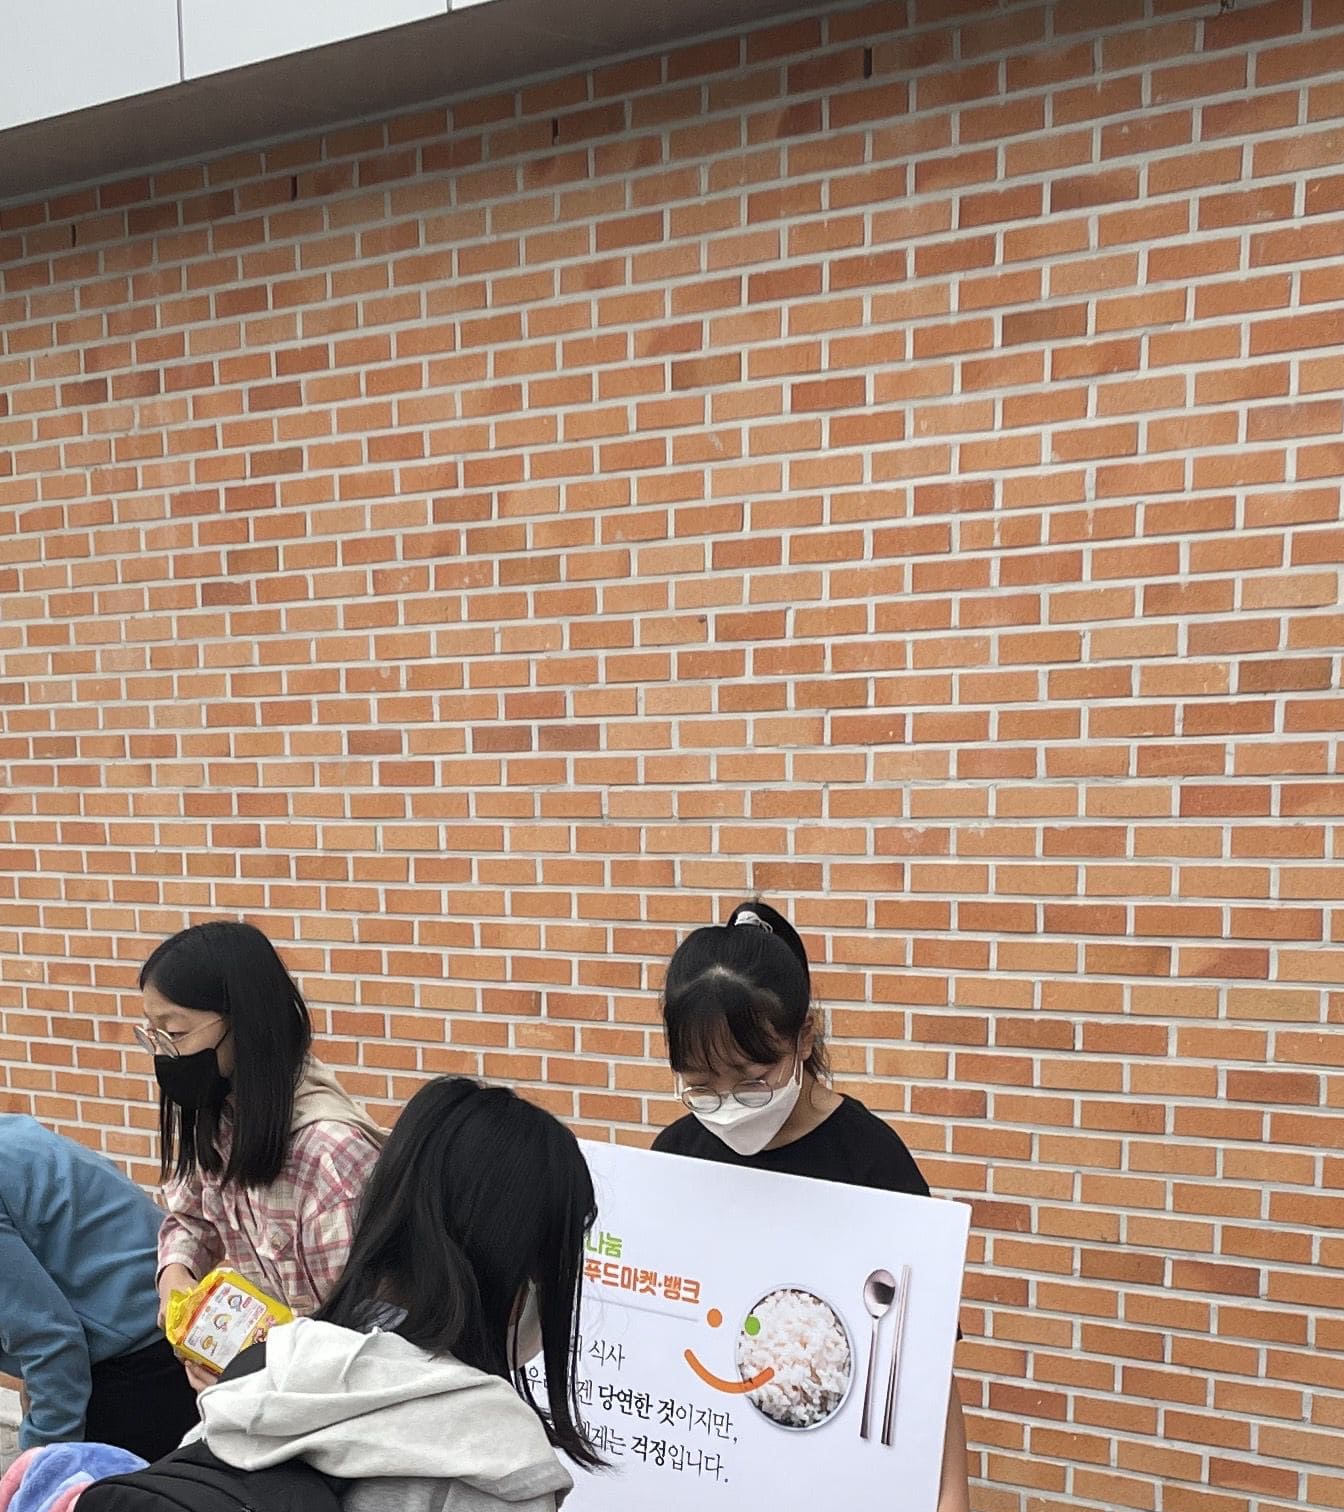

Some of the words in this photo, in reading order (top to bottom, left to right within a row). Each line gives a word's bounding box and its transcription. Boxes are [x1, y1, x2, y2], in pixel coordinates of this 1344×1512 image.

[588, 1339, 626, 1371] 식사
[598, 1384, 653, 1420] 당연한
[657, 1398, 738, 1444] 것이지만,
[631, 1435, 729, 1483] 걱정입니다.
